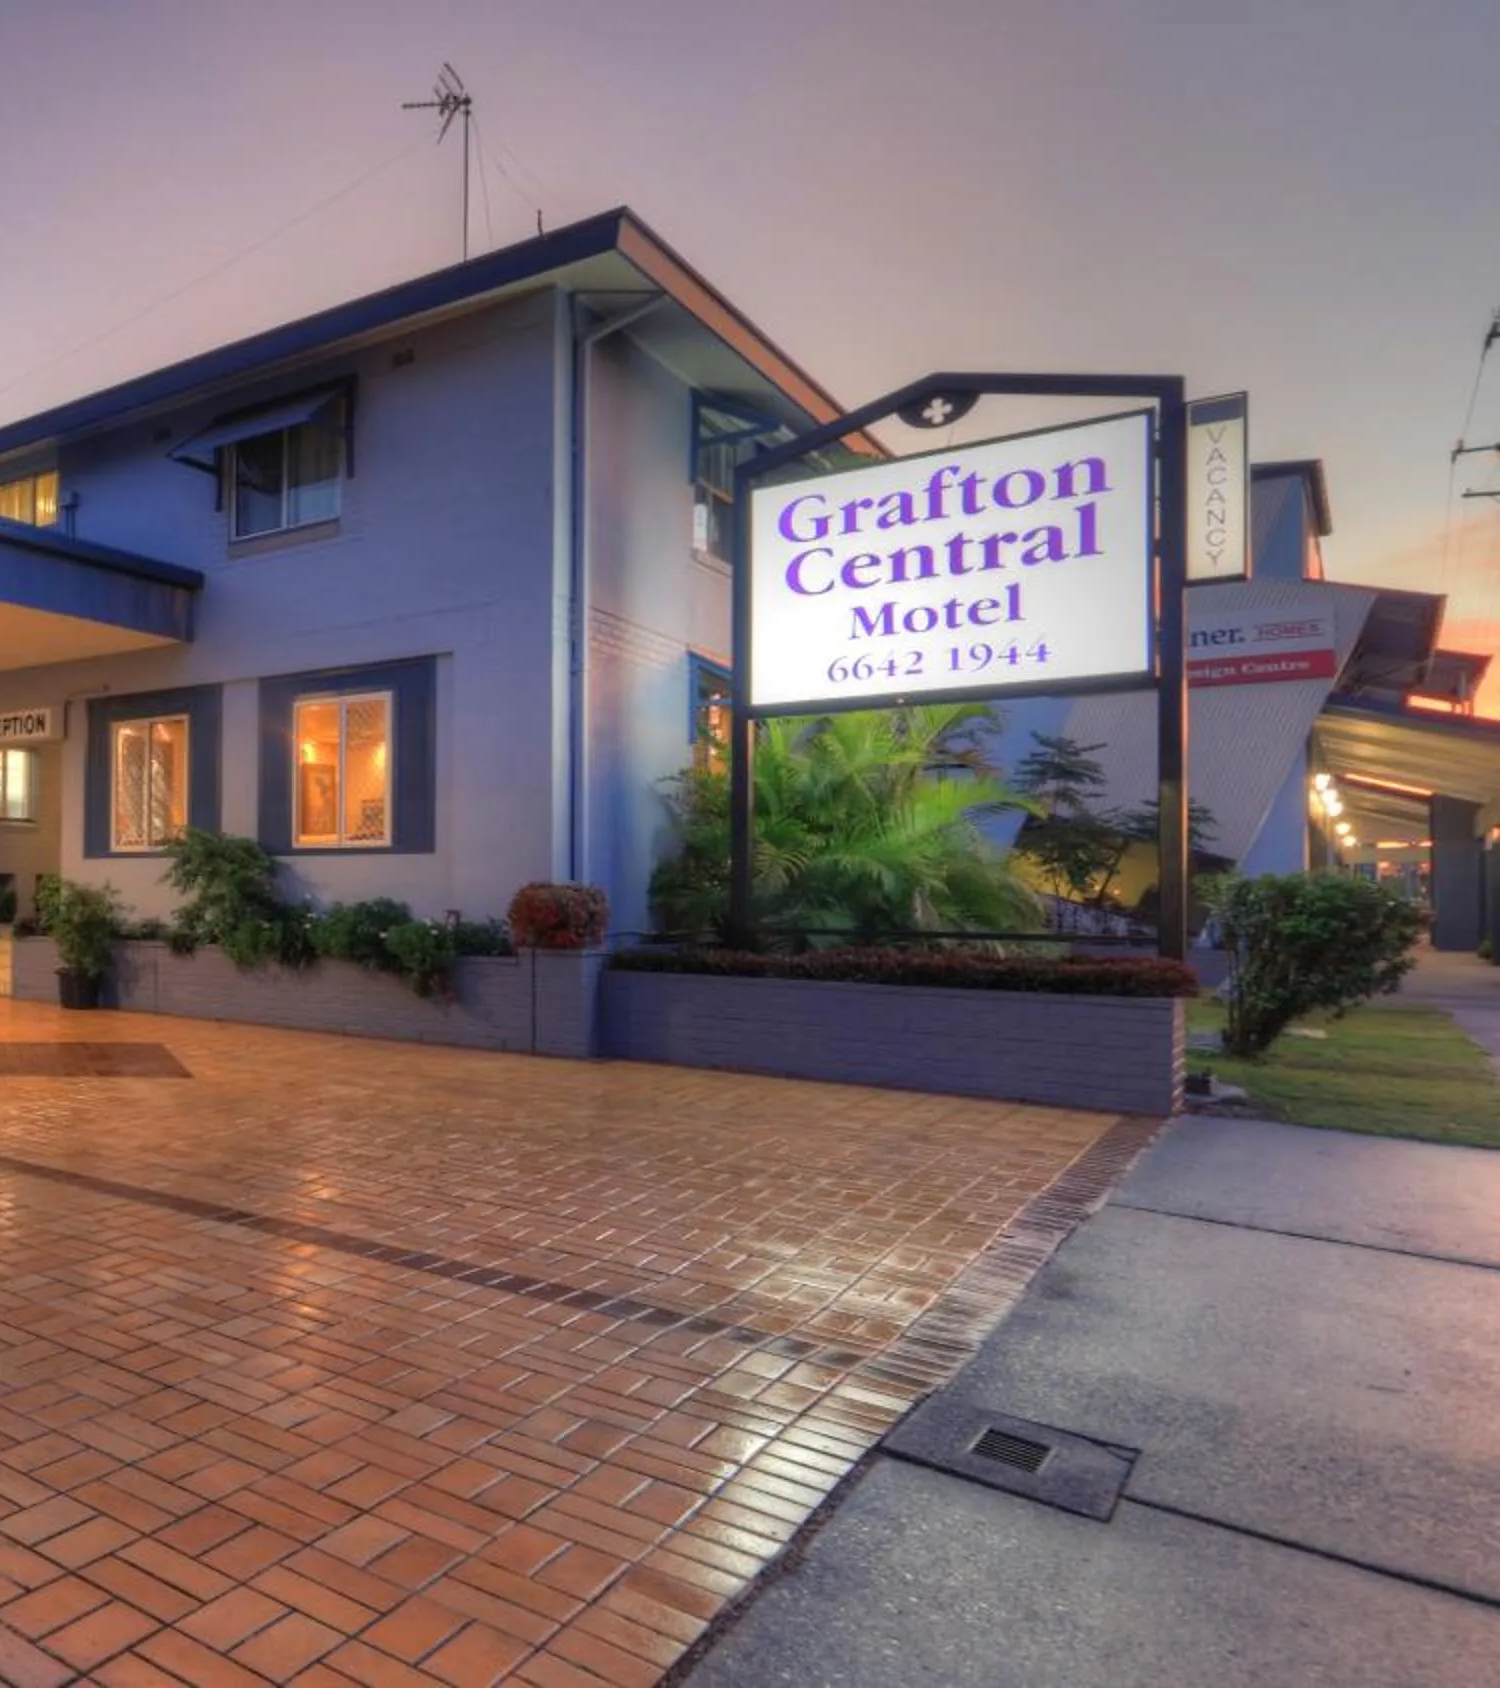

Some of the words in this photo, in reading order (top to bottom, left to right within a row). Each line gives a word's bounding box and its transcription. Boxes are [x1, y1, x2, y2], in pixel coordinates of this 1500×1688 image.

[777, 455, 1113, 543] Grafton
[1204, 425, 1227, 567] VACANCY
[784, 501, 1106, 597] Central
[848, 582, 1026, 641] Motel
[826, 649, 925, 684] 6642
[946, 633, 1052, 672] 1944
